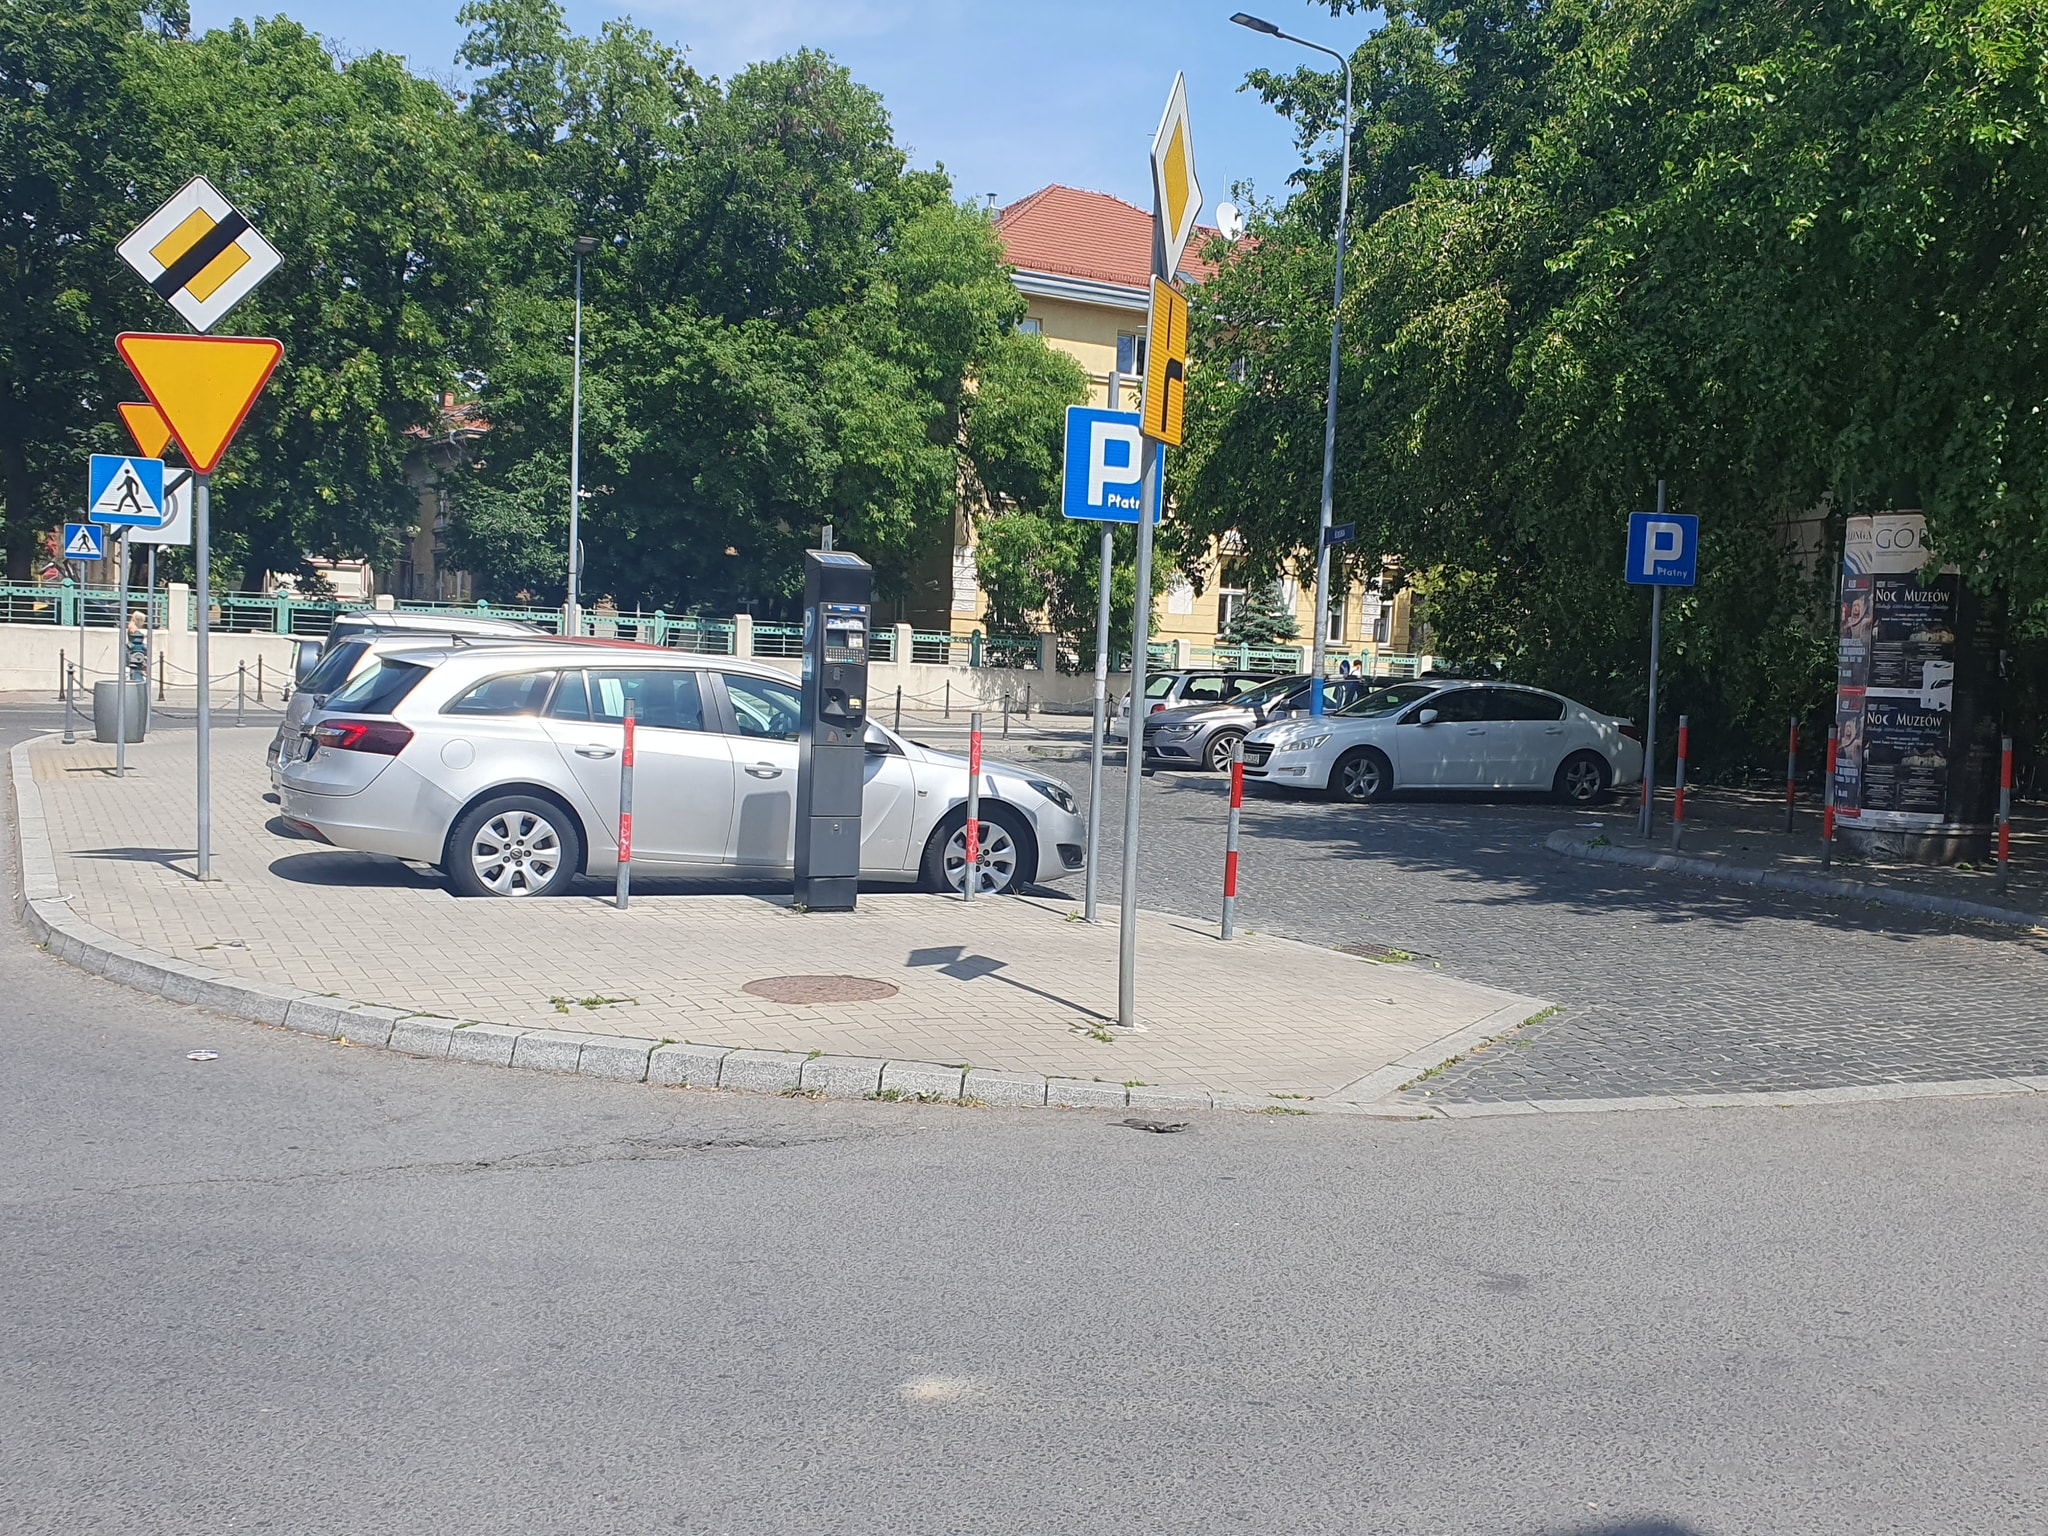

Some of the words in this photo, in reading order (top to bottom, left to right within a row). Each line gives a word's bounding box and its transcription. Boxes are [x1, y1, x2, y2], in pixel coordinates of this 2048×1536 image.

[1088, 421, 1142, 506] P
[1643, 521, 1683, 576] P
[1657, 567, 1688, 579] Płatny
